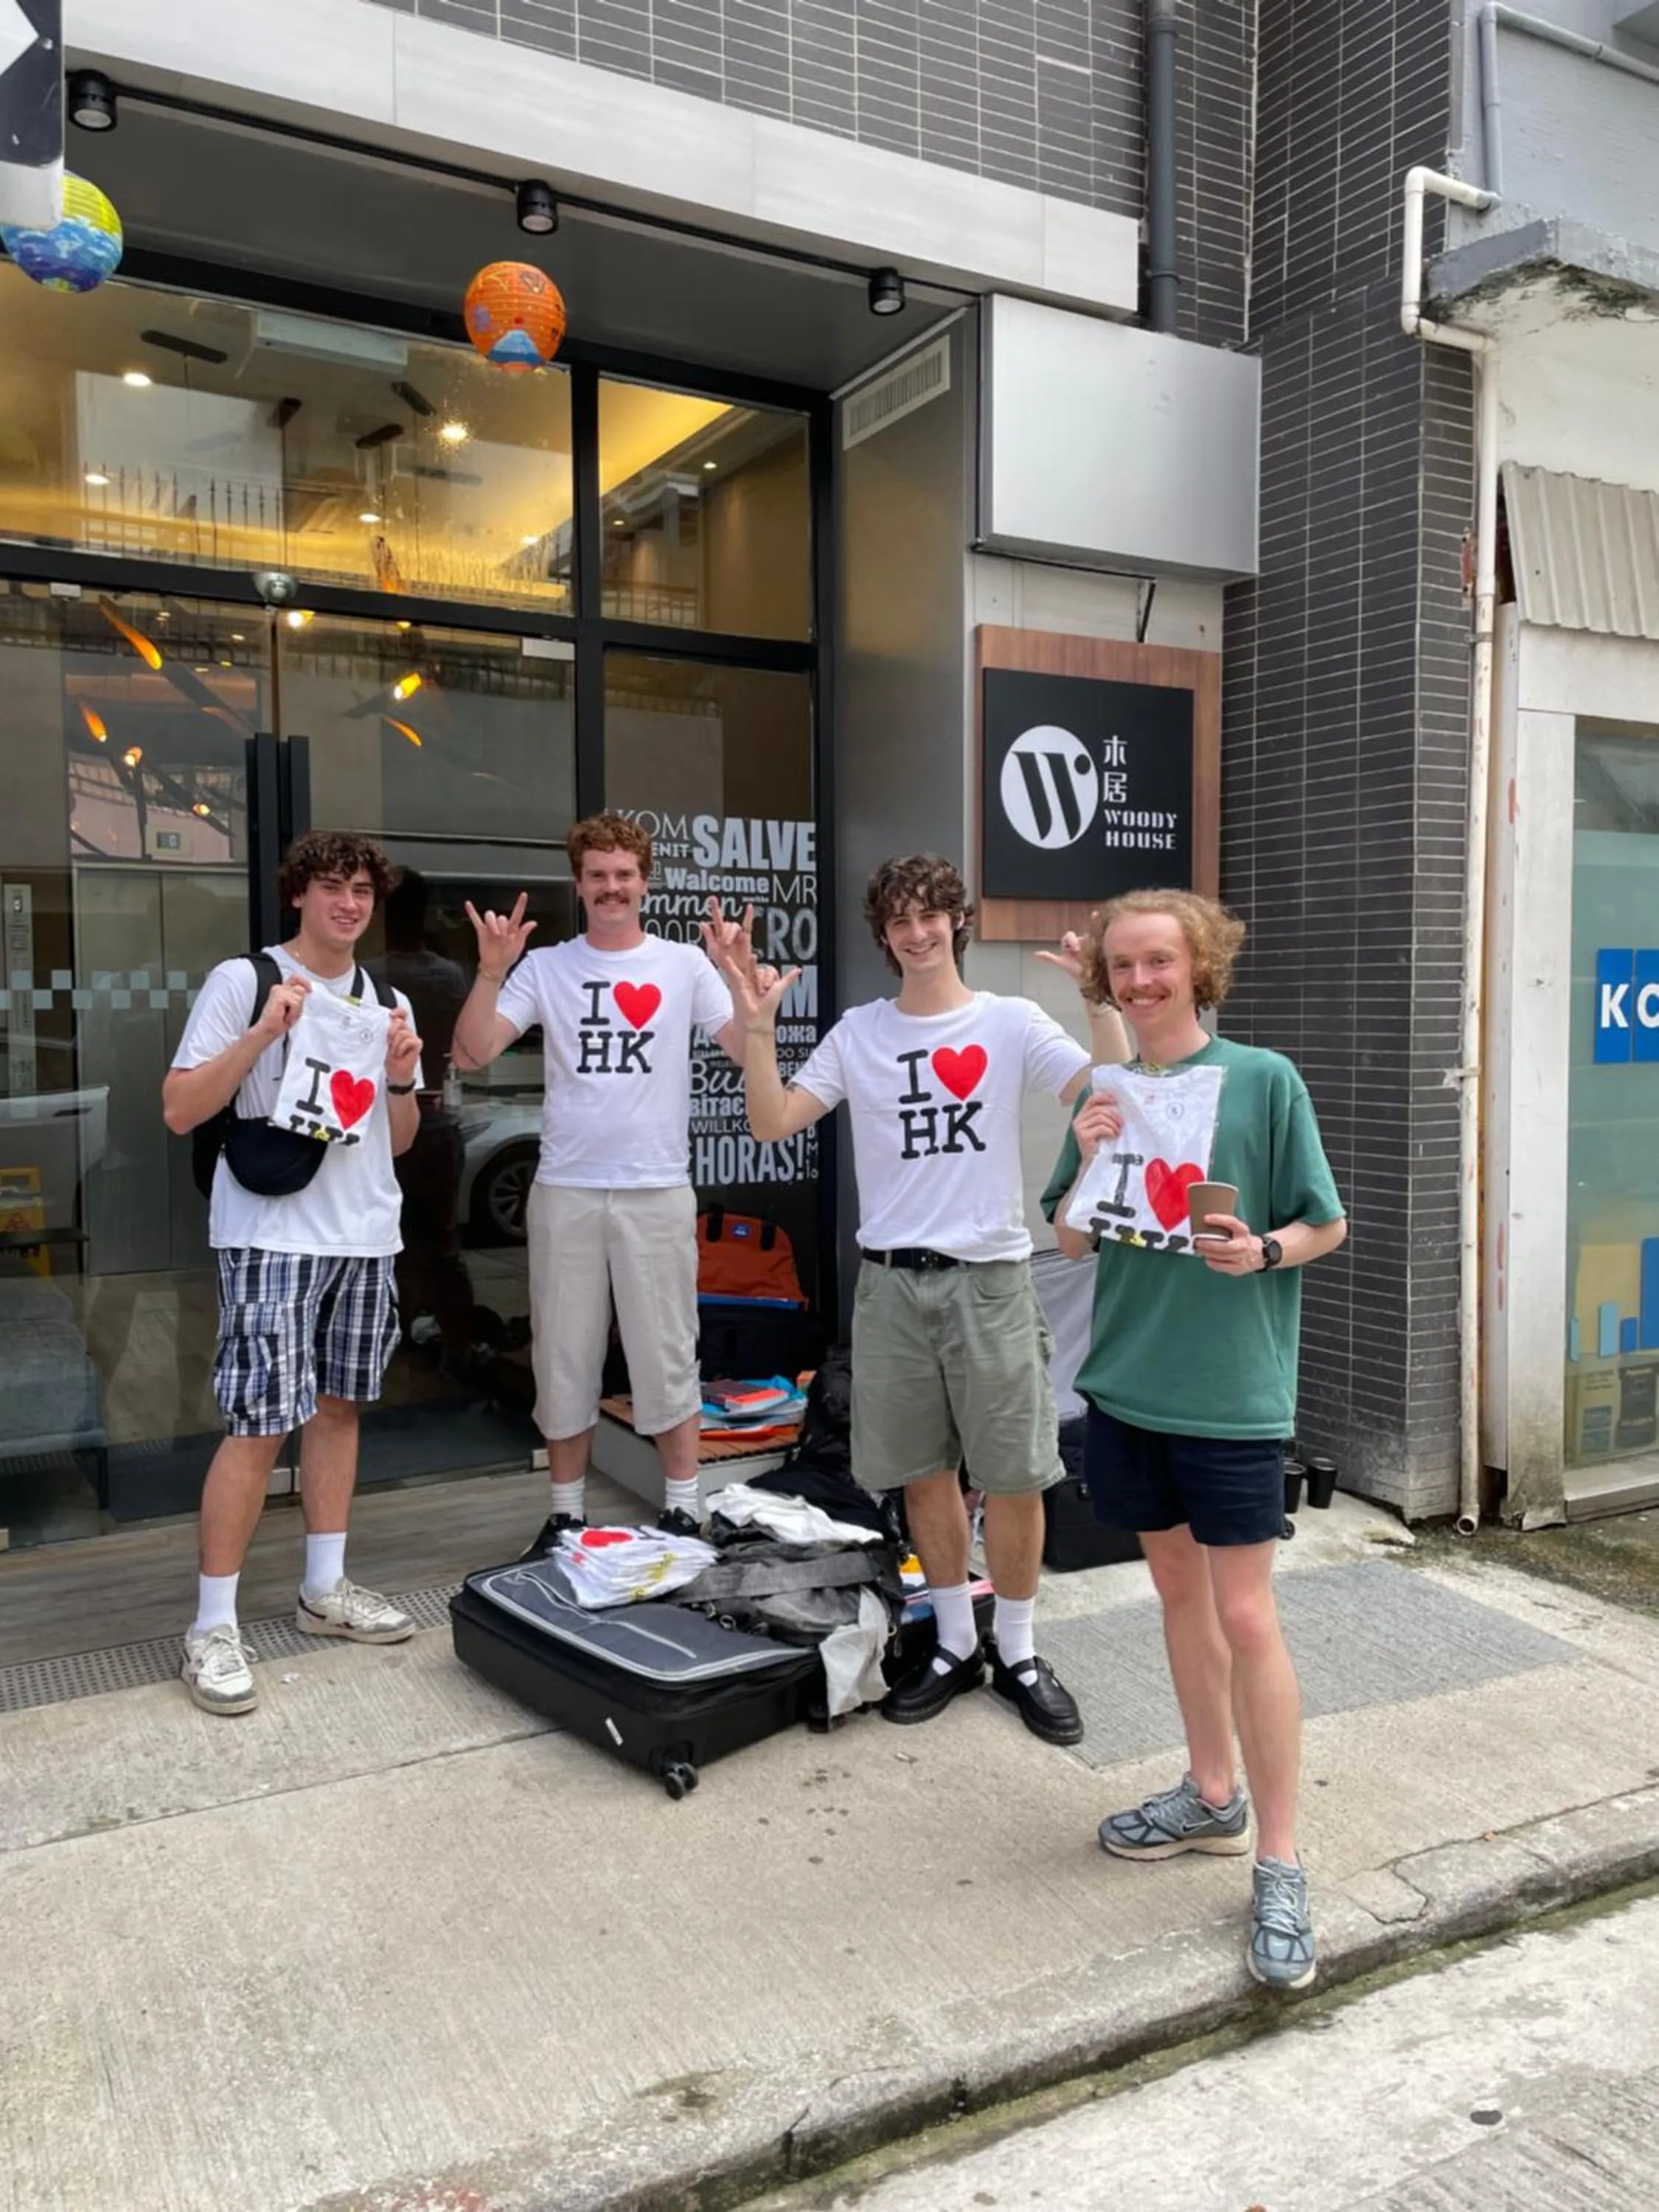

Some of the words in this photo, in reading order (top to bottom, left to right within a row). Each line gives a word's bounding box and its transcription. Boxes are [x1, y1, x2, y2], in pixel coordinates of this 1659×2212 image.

[1102, 735, 1128, 804] 木居
[692, 814, 816, 872] SALVE
[1105, 809, 1178, 830] WOODY
[1105, 830, 1177, 850] HOUSE
[580, 981, 611, 1026] I
[576, 1031, 655, 1074] HK
[897, 1049, 933, 1105] I
[295, 1057, 331, 1116] I
[898, 1101, 987, 1160] HK
[695, 1133, 804, 1186] HORAS!
[1096, 1153, 1144, 1218] I
